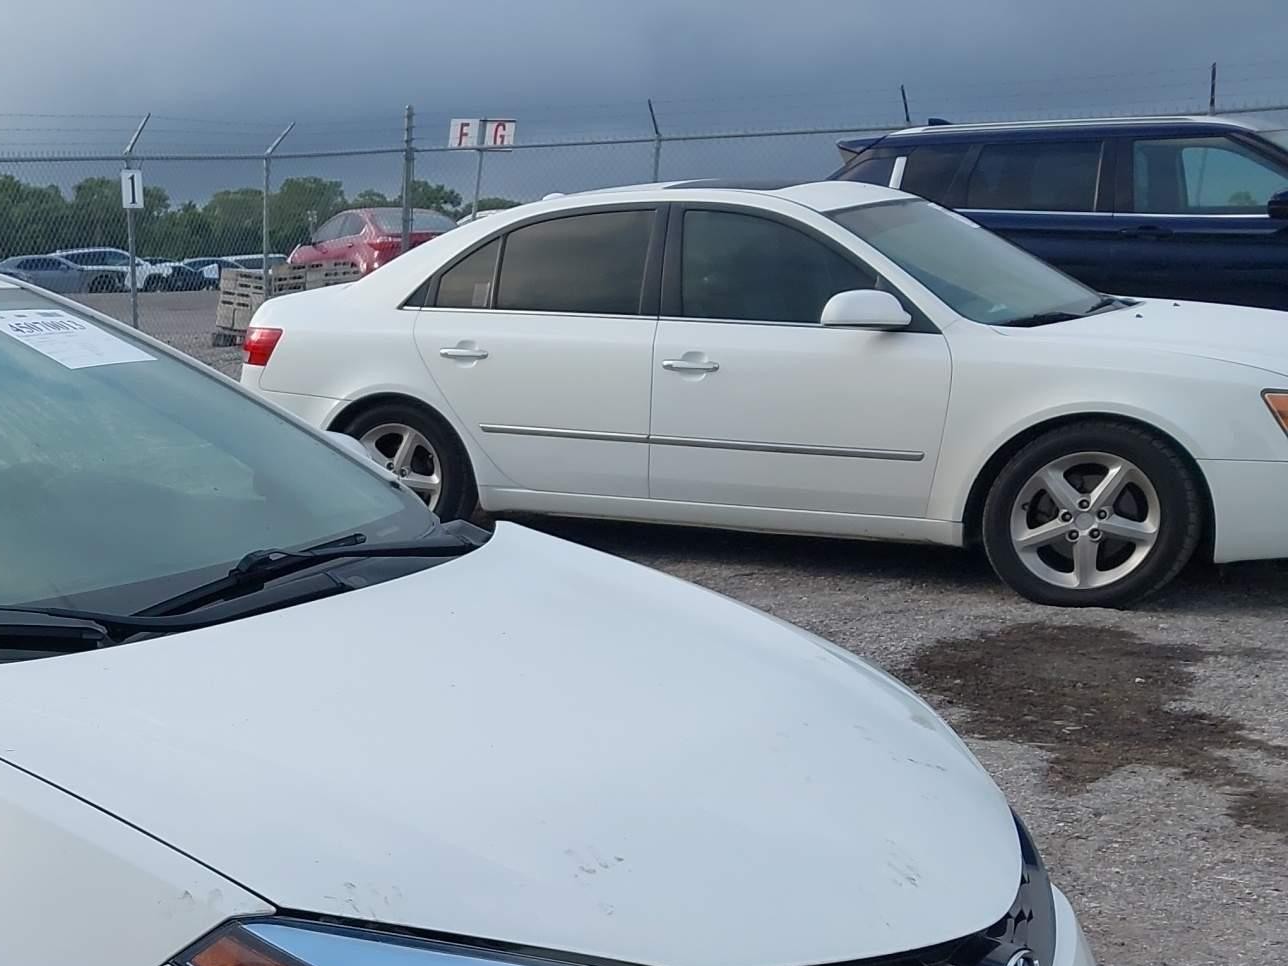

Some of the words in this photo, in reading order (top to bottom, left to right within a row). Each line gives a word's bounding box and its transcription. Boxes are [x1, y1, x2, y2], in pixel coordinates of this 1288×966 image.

[457, 122, 470, 146] F
[493, 122, 506, 145] G
[128, 174, 137, 204] 1
